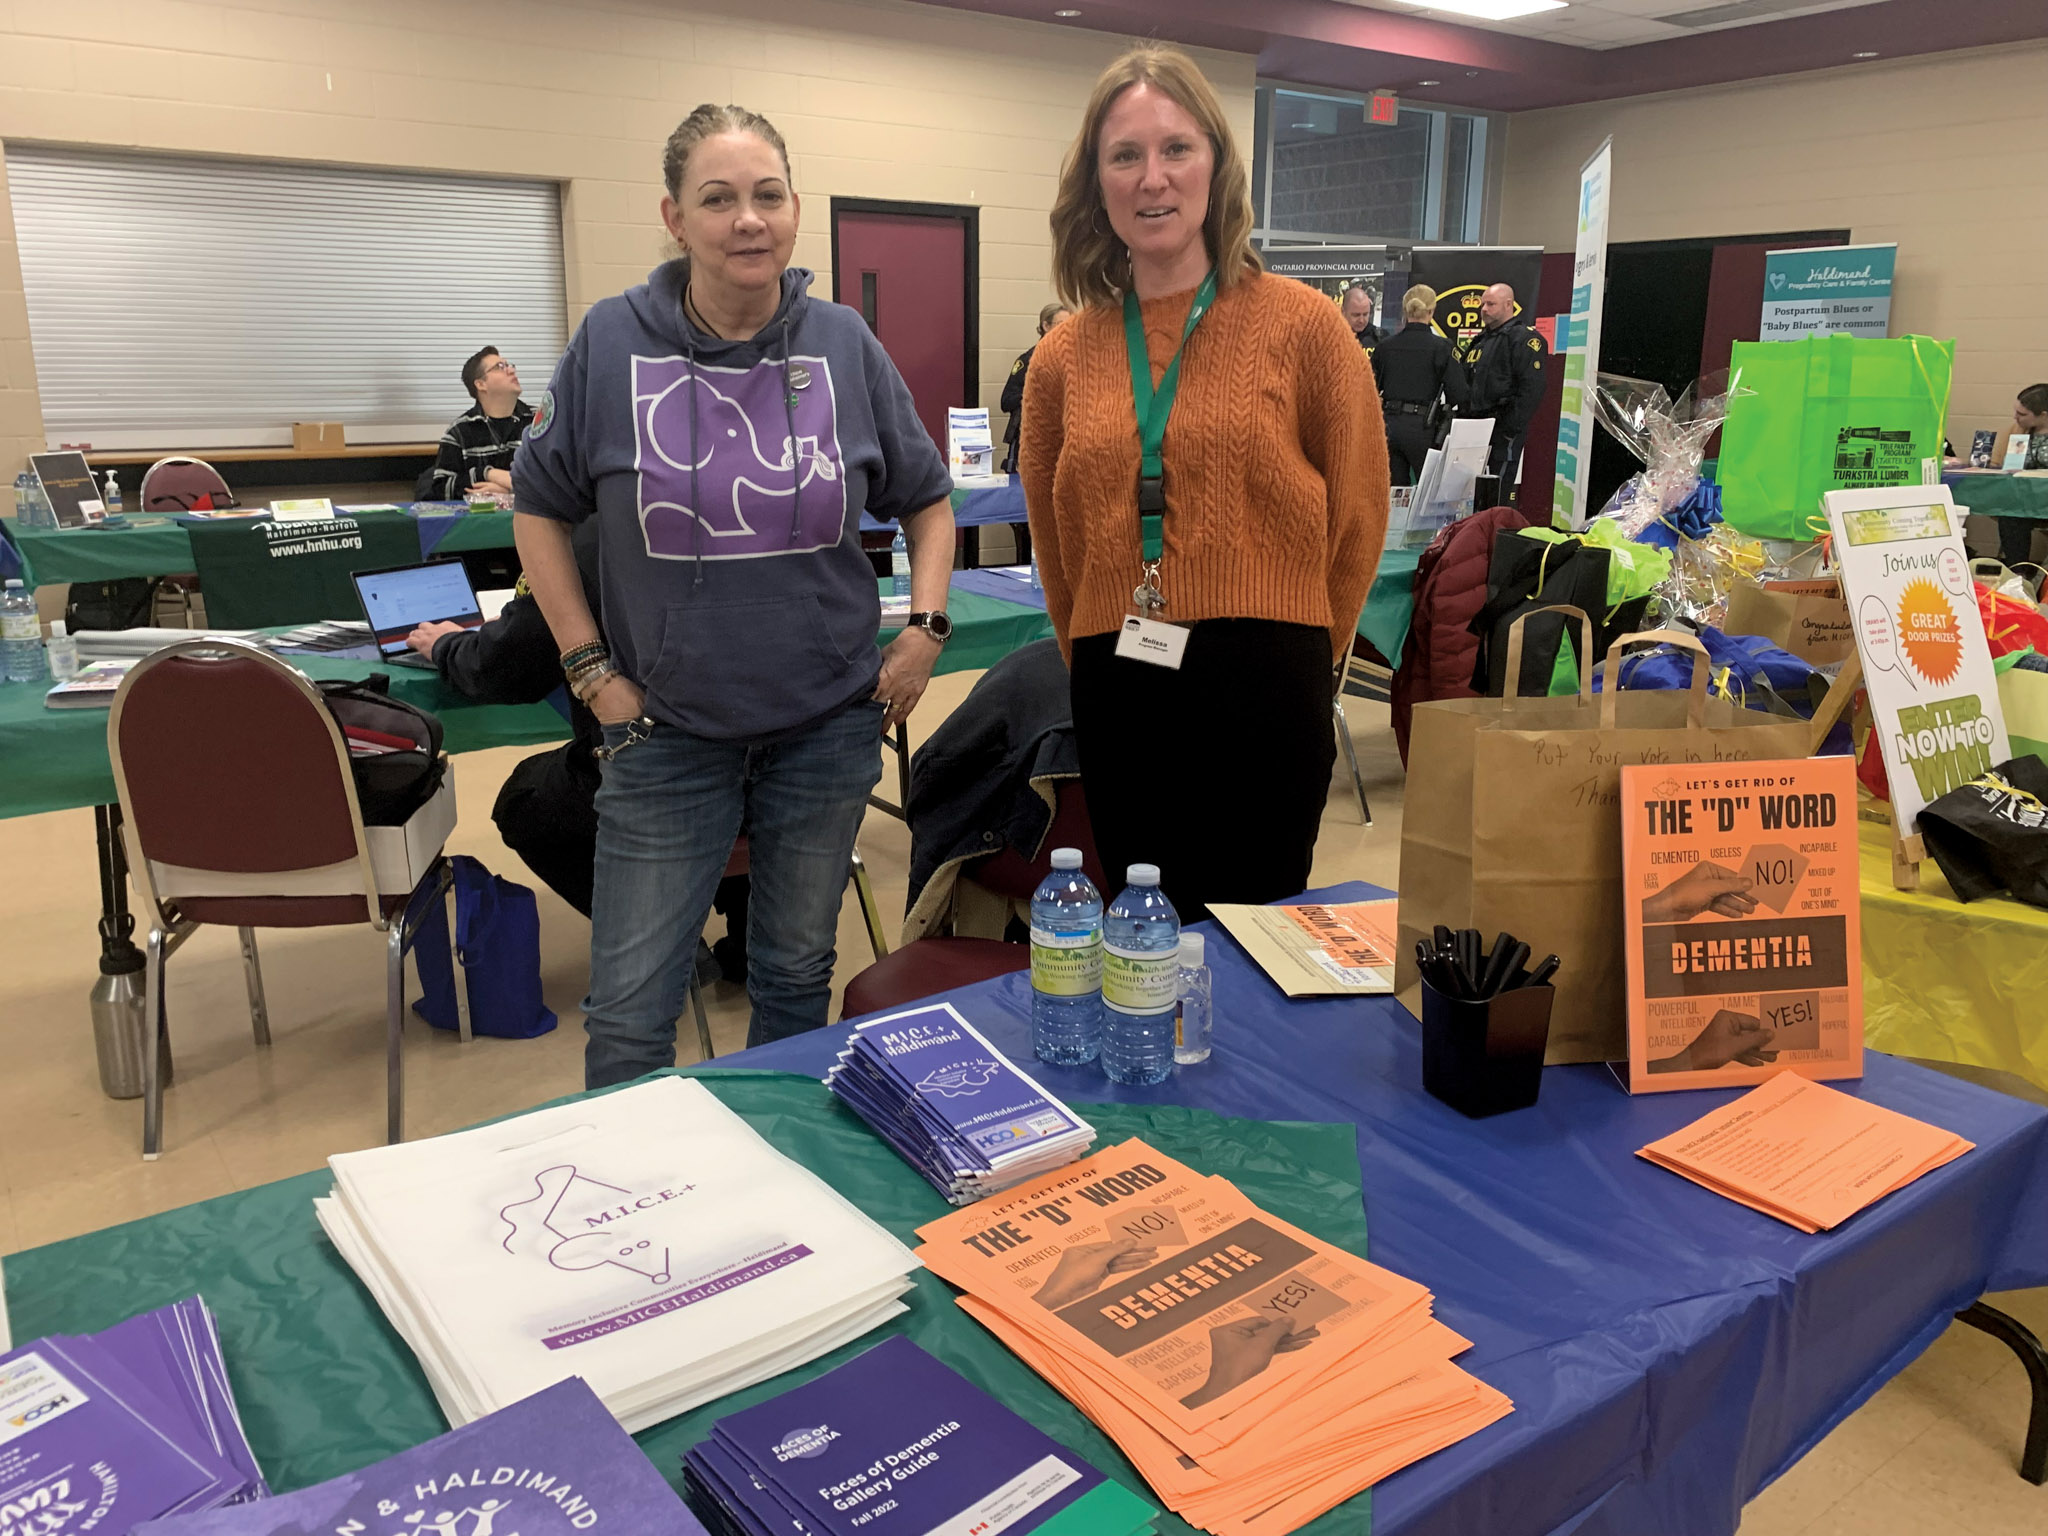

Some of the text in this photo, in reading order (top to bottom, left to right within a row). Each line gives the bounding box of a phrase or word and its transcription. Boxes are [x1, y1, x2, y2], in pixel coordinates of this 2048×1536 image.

[1372, 96, 1395, 122] EXIT
[1271, 263, 1305, 271] ONTARIO
[1305, 263, 1349, 271] PROVINCIAL
[1807, 265, 1872, 281] Haldimand
[1775, 304, 1874, 316] Postpartum Blues or
[1825, 321, 1841, 329] are
[1843, 320, 1886, 328] common
[1833, 470, 1909, 480] TURKSTRA LUMBER
[267, 521, 359, 540] Haldimand-Norfolk
[270, 536, 363, 558] www.hnhu.org
[1882, 551, 1938, 578] Join us
[1911, 613, 1947, 629] GREAT
[1142, 636, 1168, 648] Melissa
[1907, 631, 1956, 643] DOOR PRIZES
[1897, 694, 1982, 734] ENTER
[1959, 714, 1994, 749] TO
[1533, 739, 1568, 766] Put
[1685, 748, 1702, 763] in
[1686, 777, 1796, 790] LET'S GET RID OF
[1644, 793, 1837, 836] THE "D" WORD
[1651, 850, 1700, 865] DEMENTED
[1710, 847, 1742, 858] USELESS
[1799, 842, 1838, 854] INCAPABLE
[1643, 873, 1658, 881] LESS
[1643, 880, 1659, 889] THAN
[1756, 859, 1795, 886] NO!
[1808, 867, 1836, 877] MIXED UP
[1824, 887, 1833, 896] OF
[1671, 935, 1813, 974] DEMENTIA
[1648, 1001, 1699, 1017] POWERFUL
[1660, 1016, 1707, 1029] INTELLIGENT
[1767, 1000, 1814, 1028] YES!
[885, 1029, 961, 1058] Haldimand
[1647, 1034, 1687, 1048] CAPABLE
[1788, 1049, 1834, 1061] INDIVIDUAL
[992, 1168, 1098, 1217] LET'S GET RID OF
[961, 1163, 1167, 1258] THE "D" WORD
[1065, 1224, 1101, 1244] USELESS
[1121, 1211, 1175, 1240] NO!
[1005, 1245, 1062, 1274] DEMENTED
[548, 1318, 587, 1334] Memory
[588, 1304, 629, 1320] Inclusive
[630, 1283, 687, 1306] Communities
[687, 1262, 736, 1285] Everywhere
[743, 1241, 788, 1263] Haldimand
[558, 1252, 799, 1346] www.MICEHaldimand.ca
[1100, 1244, 1263, 1330] DEMENTIA
[1262, 1279, 1316, 1315] YES!
[1126, 1336, 1191, 1369] POWERFUL
[1156, 1362, 1208, 1391] CAPABLE
[771, 1424, 830, 1455] FACES OF
[776, 1430, 842, 1463] DEMENTIA
[818, 1420, 961, 1501] Faces of Dementia
[833, 1451, 940, 1512] Gallery Guide
[79, 1460, 119, 1531] HAMILTON
[377, 1498, 401, 1517] &
[414, 1467, 599, 1530] HALDIMAND
[851, 1498, 899, 1528] Fall 2022
